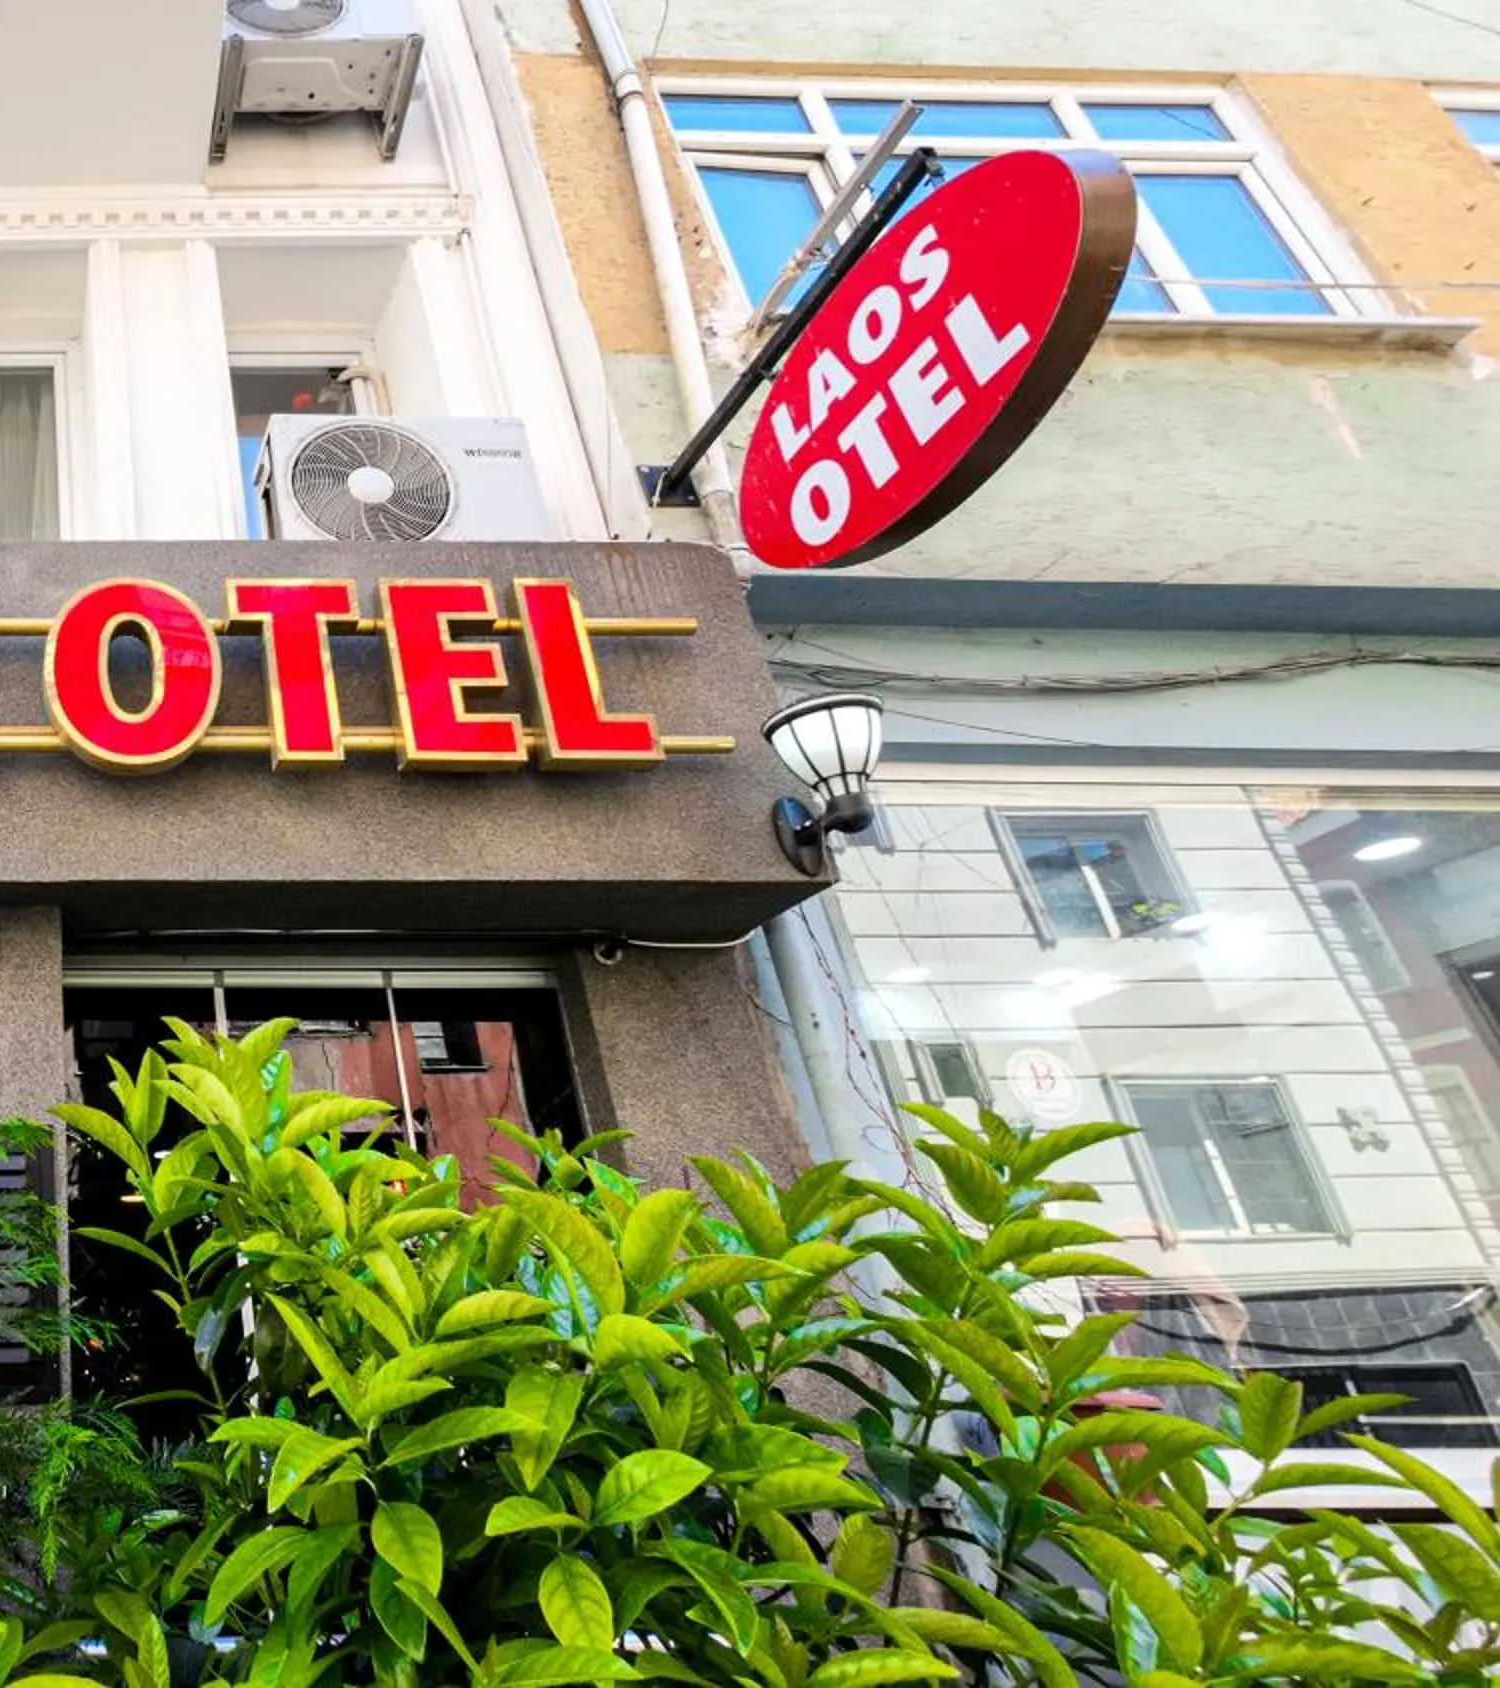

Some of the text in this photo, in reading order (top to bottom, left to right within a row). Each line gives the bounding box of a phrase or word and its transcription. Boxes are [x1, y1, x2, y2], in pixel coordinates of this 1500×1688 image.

[770, 223, 949, 463] LAOS
[790, 293, 1031, 546] OTEL
[43, 577, 667, 774] OTEL
